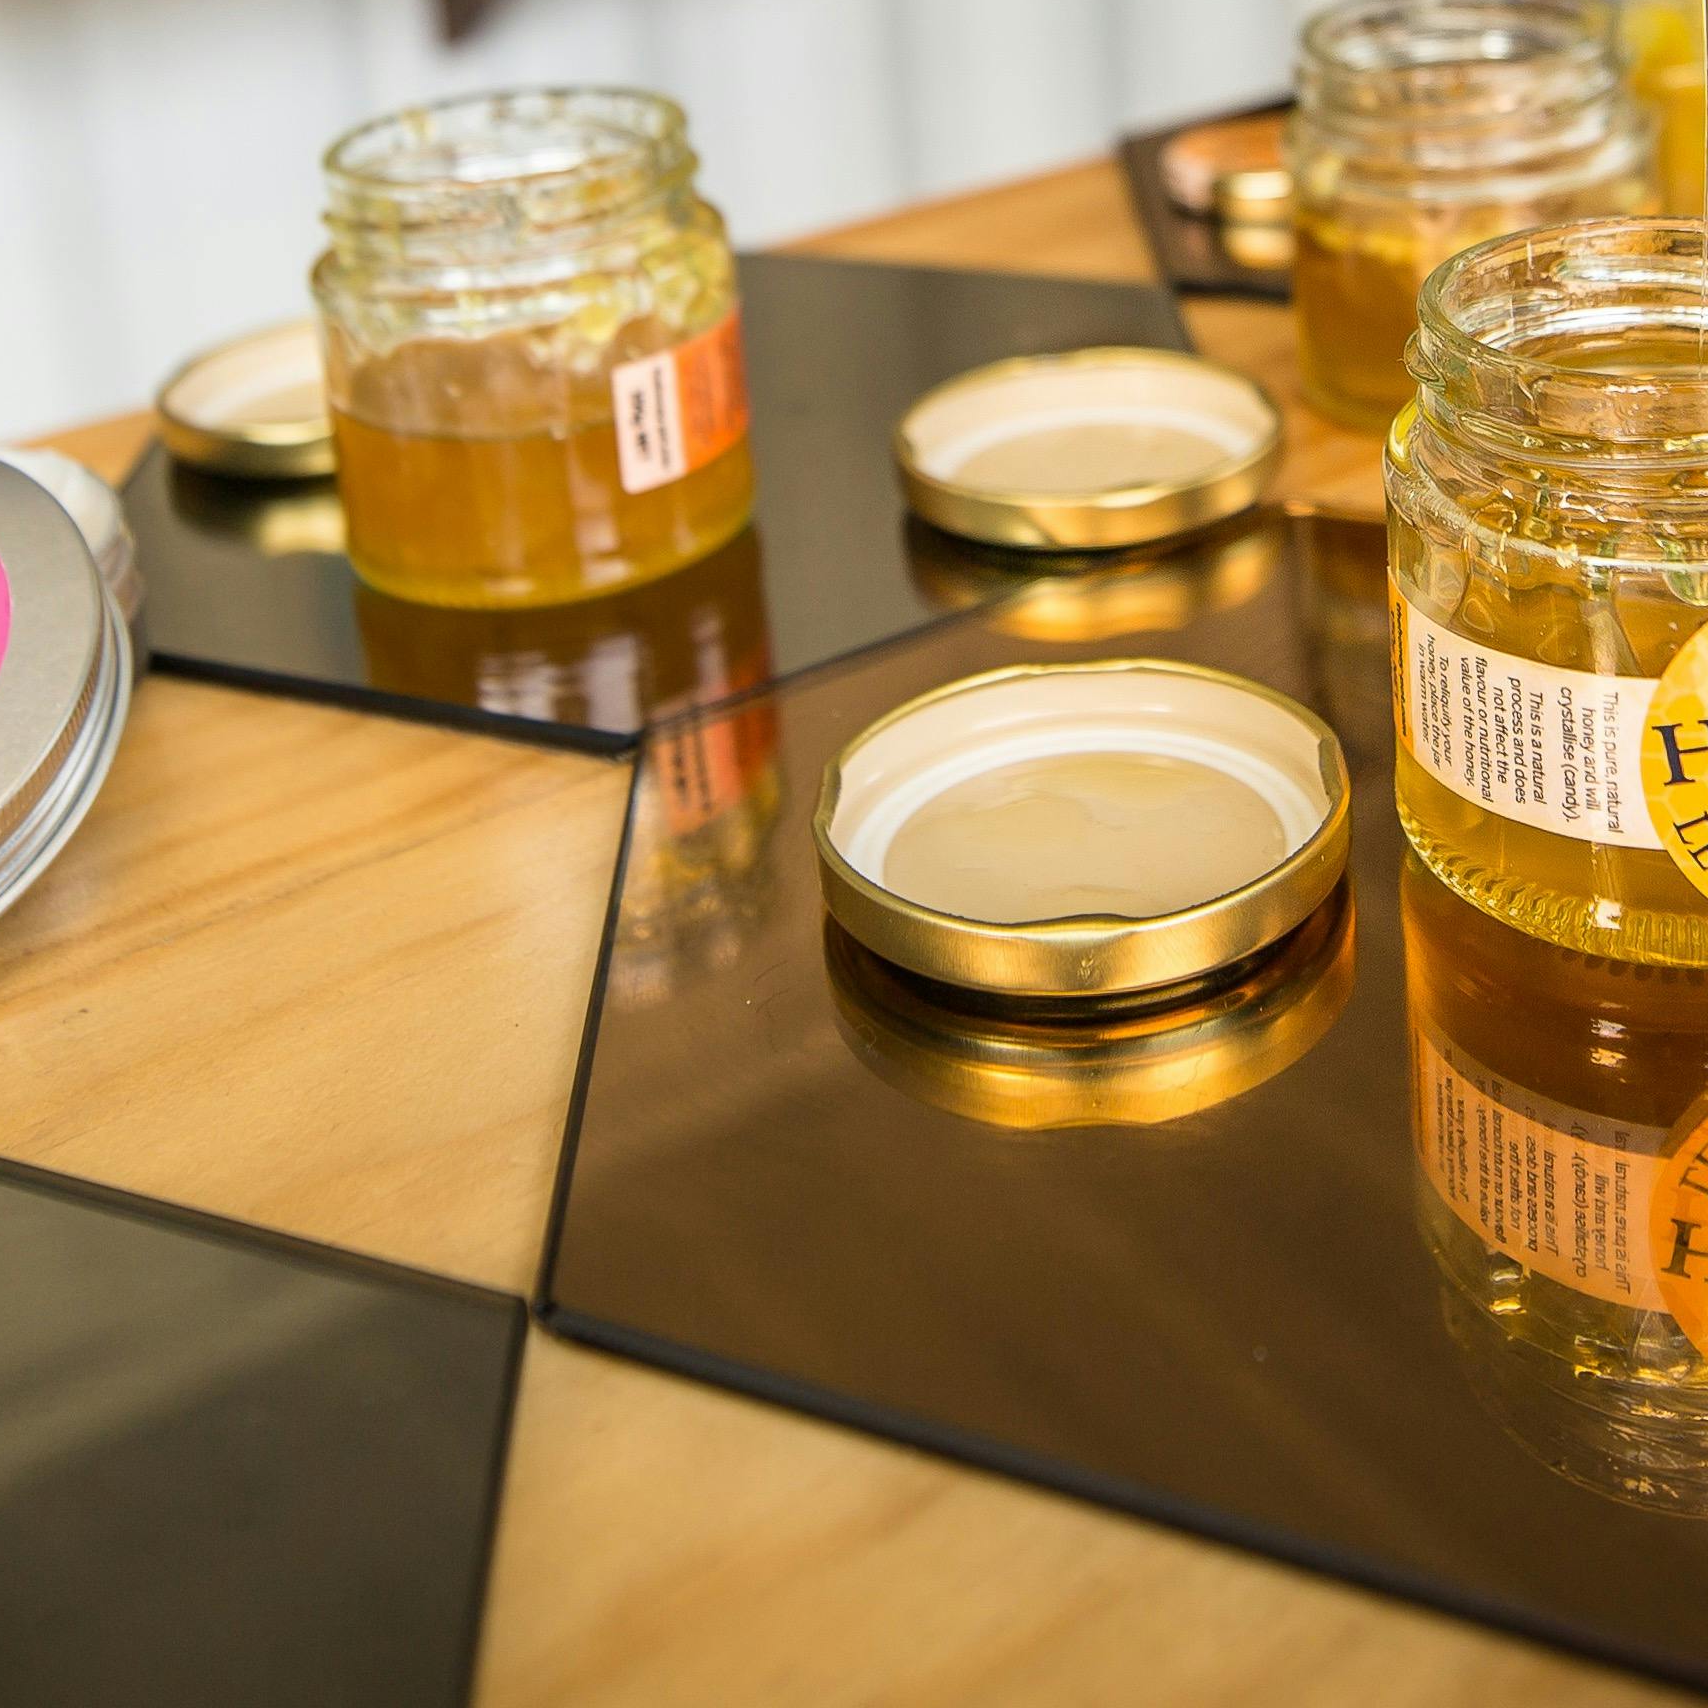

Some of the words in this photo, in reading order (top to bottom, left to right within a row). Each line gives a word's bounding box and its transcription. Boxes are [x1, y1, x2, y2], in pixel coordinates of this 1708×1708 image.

[1418, 643, 1425, 657] in
[1439, 656, 1448, 671] To
[1420, 659, 1428, 699] warm
[1461, 657, 1472, 695] value
[1475, 656, 1488, 708] flavour
[1429, 680, 1439, 723] place
[1462, 697, 1474, 713] of
[1493, 686, 1505, 712] not
[1507, 676, 1523, 735] process
[1530, 692, 1543, 721] This
[1603, 691, 1619, 723] This
[1464, 715, 1475, 738] the
[1478, 710, 1488, 726] or
[1531, 724, 1544, 737] is
[1557, 686, 1577, 760] crystallise
[1580, 707, 1596, 754] honey
[1604, 726, 1620, 739] is
[1431, 725, 1440, 746] the
[1443, 733, 1452, 768] your
[1494, 714, 1509, 757] affect
[1531, 739, 1542, 749] a
[1432, 747, 1441, 770] jar
[1464, 741, 1475, 787] honey.
[1479, 726, 1494, 802] nutritional
[1514, 737, 1527, 768] and
[1603, 742, 1618, 778] pure,
[1497, 758, 1510, 784] the
[1532, 751, 1548, 805] natural
[1584, 756, 1601, 784] and
[1514, 769, 1526, 804] does
[1561, 764, 1581, 823] (candy).
[1586, 786, 1602, 811] will
[1606, 781, 1624, 834] natural
